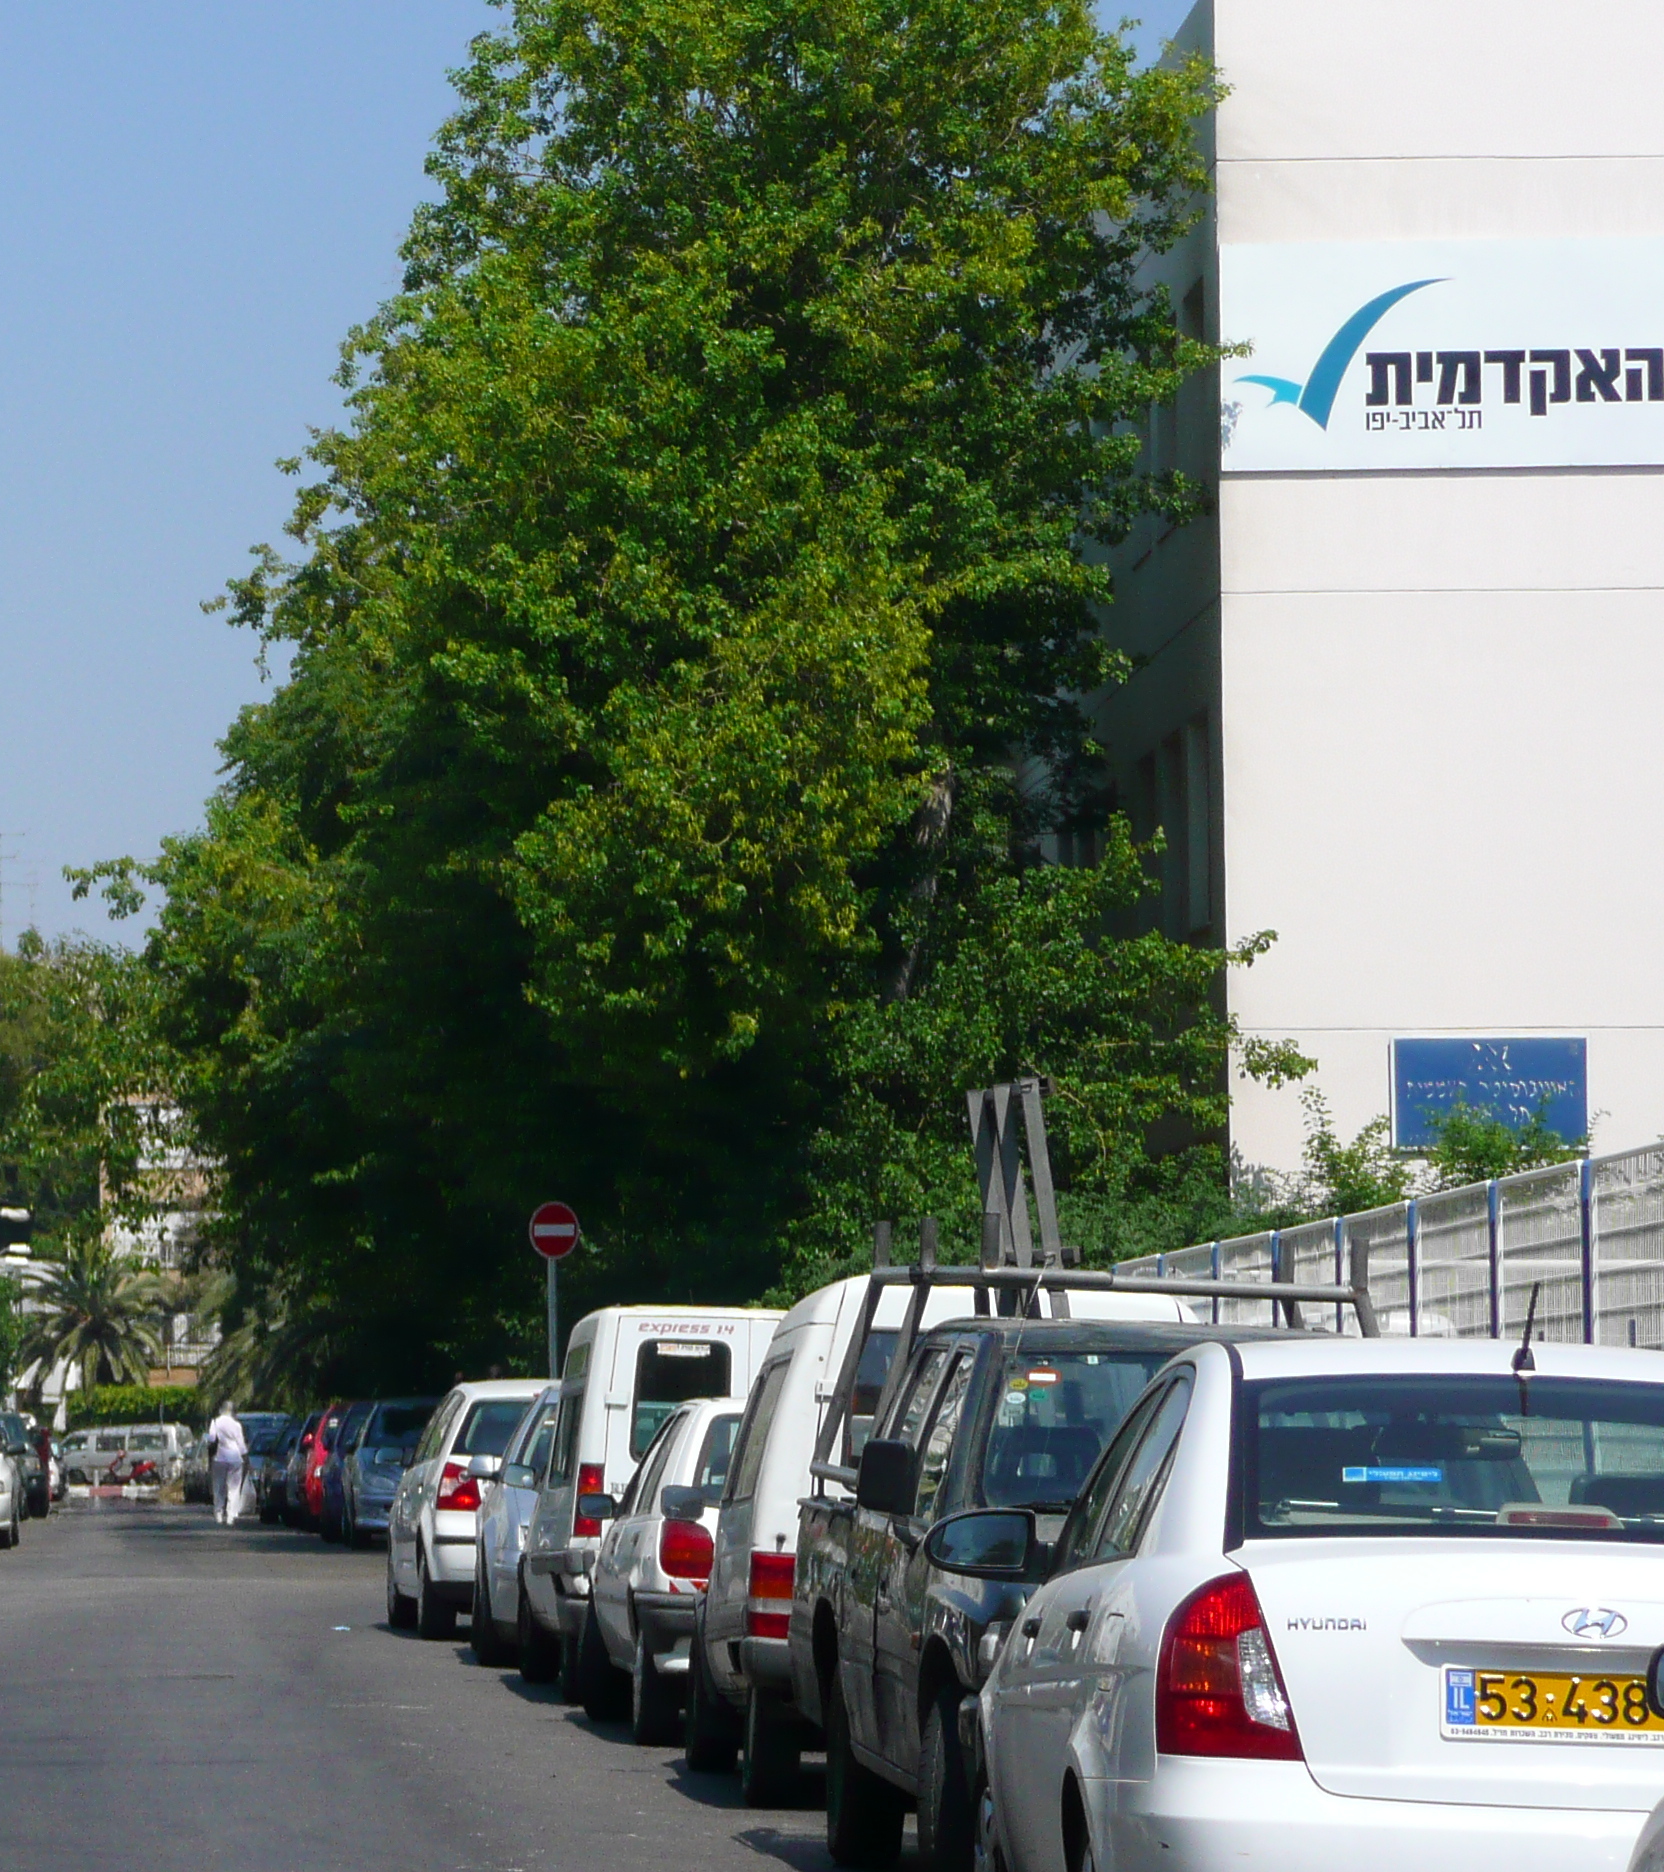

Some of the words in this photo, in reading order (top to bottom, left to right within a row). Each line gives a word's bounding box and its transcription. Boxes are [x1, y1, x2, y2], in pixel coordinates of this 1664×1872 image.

[1365, 347, 1664, 416] האקדמית
[638, 1322, 711, 1336] express
[1287, 1617, 1367, 1631] HYUNDAI
[1453, 1686, 1470, 1709] IL
